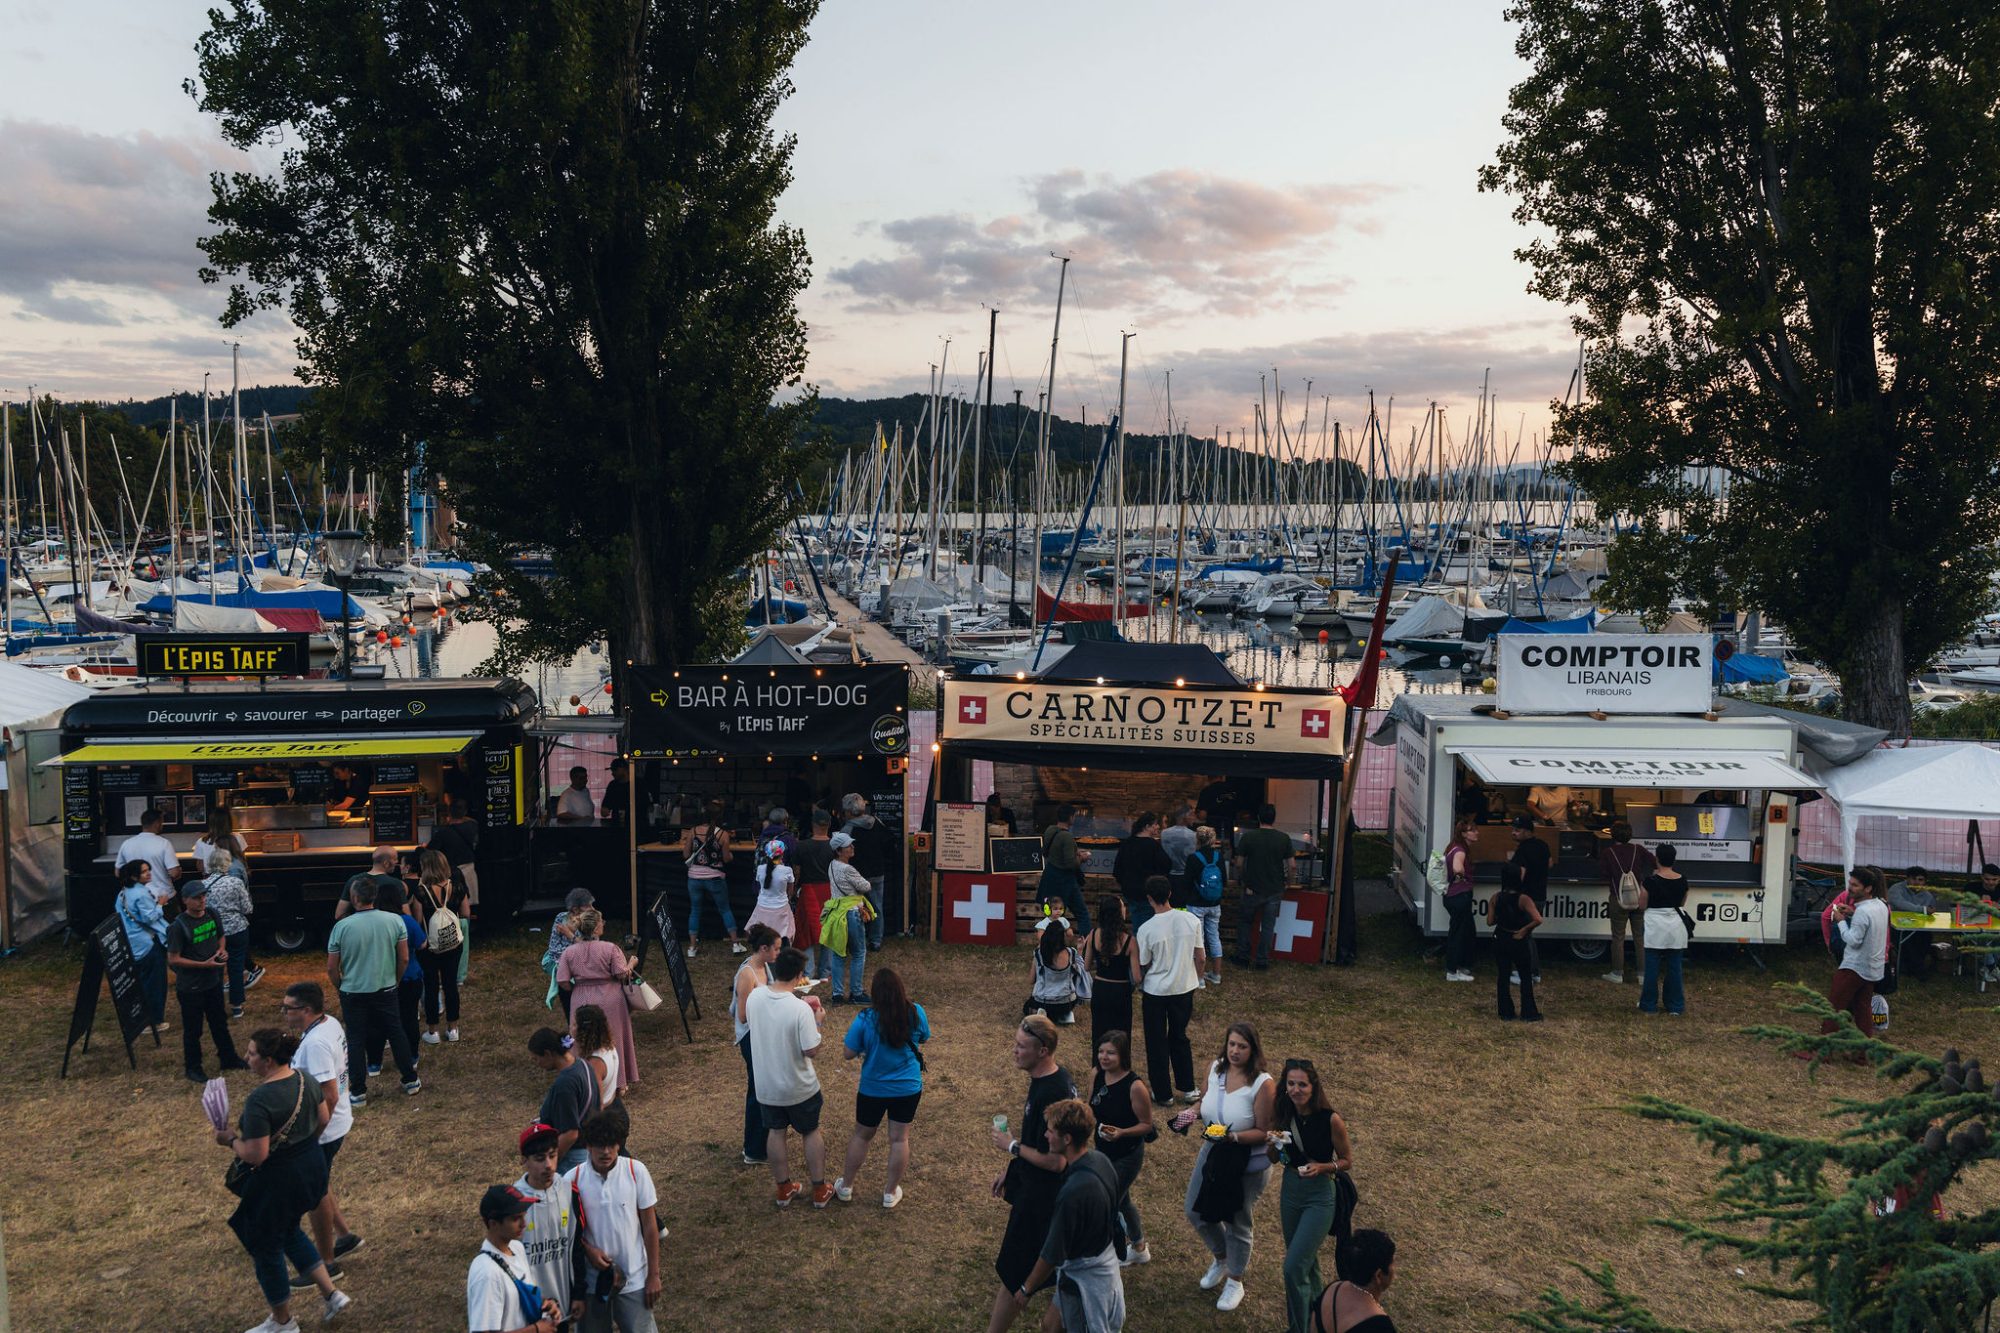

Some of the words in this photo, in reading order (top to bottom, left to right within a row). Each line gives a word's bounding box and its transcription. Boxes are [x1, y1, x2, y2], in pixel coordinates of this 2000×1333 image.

[1521, 645, 1702, 668] COMPTOIR
[1567, 671, 1651, 685] LIBANAIS
[678, 685, 726, 707] BAR
[733, 679, 750, 707] À
[757, 684, 867, 707] HOT-DOG
[1586, 688, 1632, 696] FRIBOURG
[147, 710, 218, 723] Découvrir
[244, 708, 308, 721] savourer
[341, 707, 402, 723] partager
[1006, 690, 1282, 729] CARNOTZET
[719, 721, 731, 733] By
[874, 724, 905, 740] Qualité
[1030, 721, 1164, 741] SPÉCIALITÉS
[1173, 729, 1256, 745] SUISSES
[891, 759, 899, 769] B
[1508, 758, 1747, 771] COMPTOIR
[1566, 768, 1706, 776] LIBANAIS
[1774, 809, 1782, 819] B
[917, 836, 925, 847] B
[1031, 852, 1040, 863] 8
